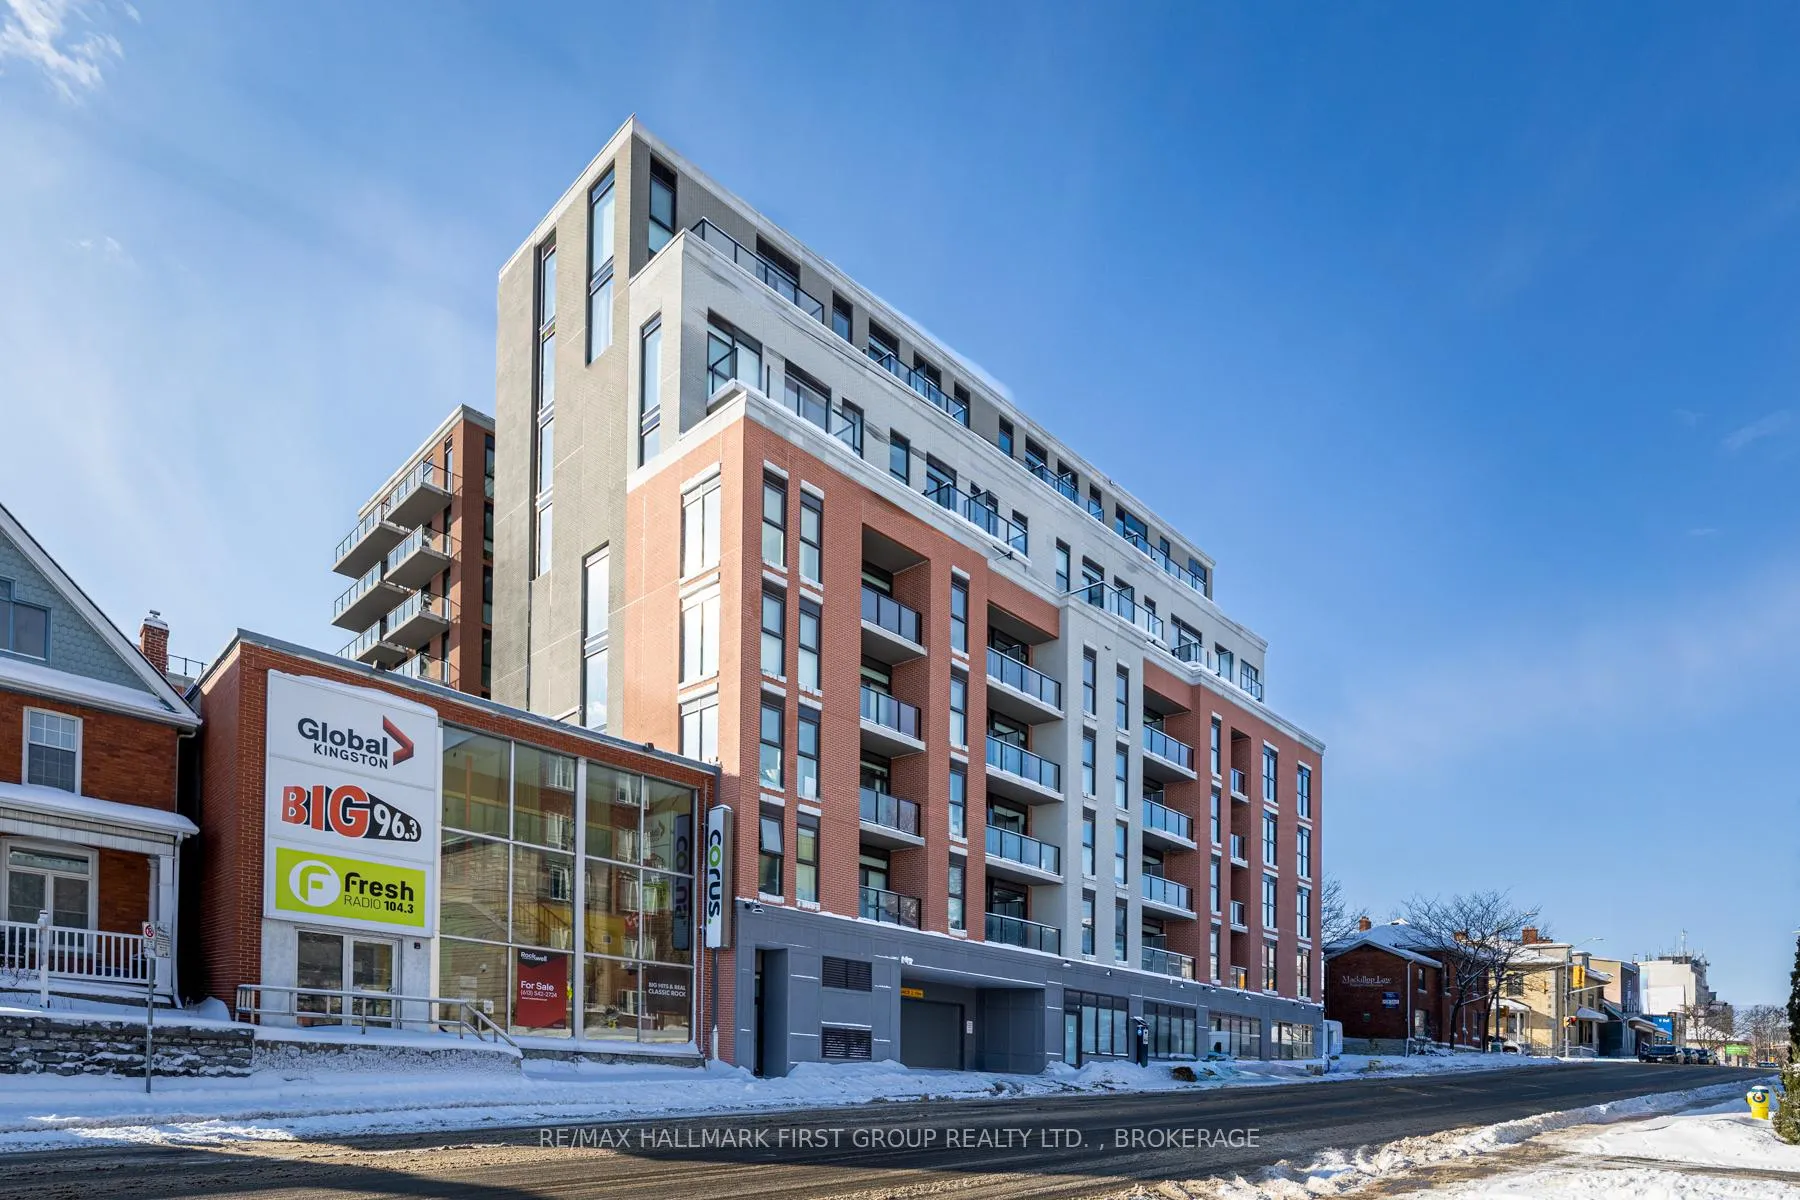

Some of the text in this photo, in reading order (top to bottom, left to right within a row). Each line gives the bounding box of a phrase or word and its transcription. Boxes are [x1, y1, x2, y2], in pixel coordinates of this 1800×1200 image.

[297, 717, 388, 757] Global
[313, 742, 389, 770] KINGSTON
[281, 784, 419, 841] BIG 96.3
[343, 894, 414, 914] RADIO 104.3
[521, 980, 554, 991] For Sale
